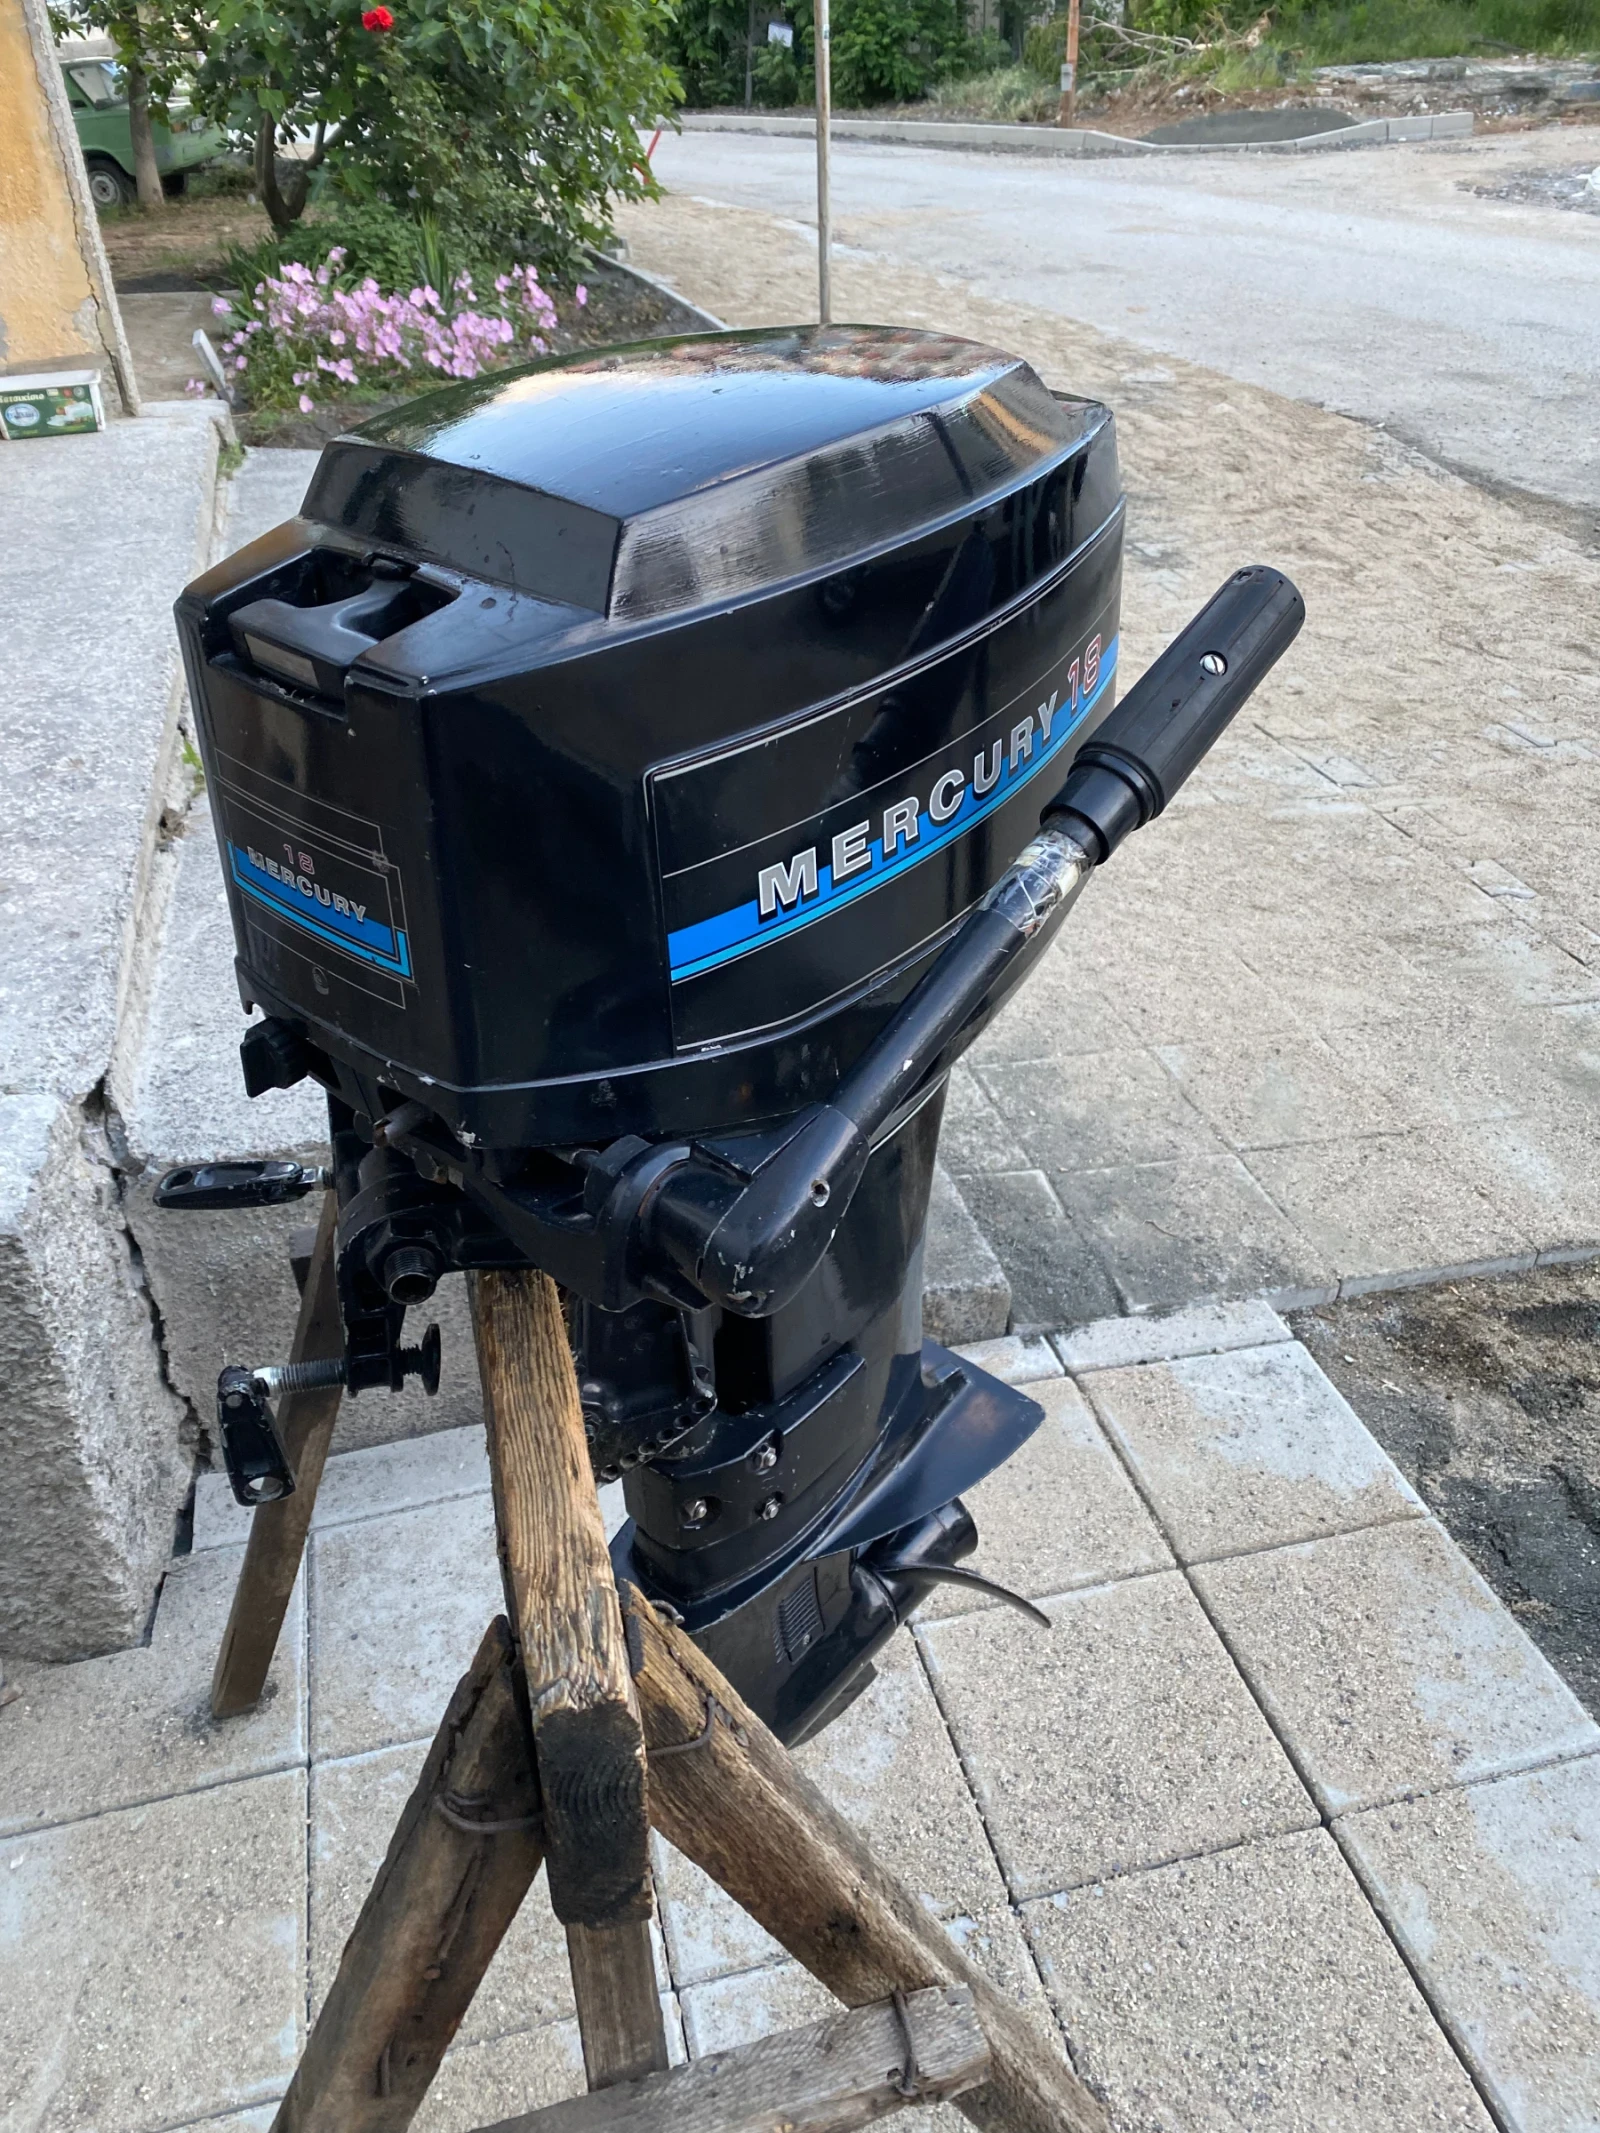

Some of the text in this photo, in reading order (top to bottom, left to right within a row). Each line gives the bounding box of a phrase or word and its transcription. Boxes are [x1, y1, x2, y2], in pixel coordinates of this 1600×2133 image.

[758, 632, 1101, 916] MERCURY 18
[247, 846, 367, 923] MERCURY
[283, 843, 315, 875] 18
